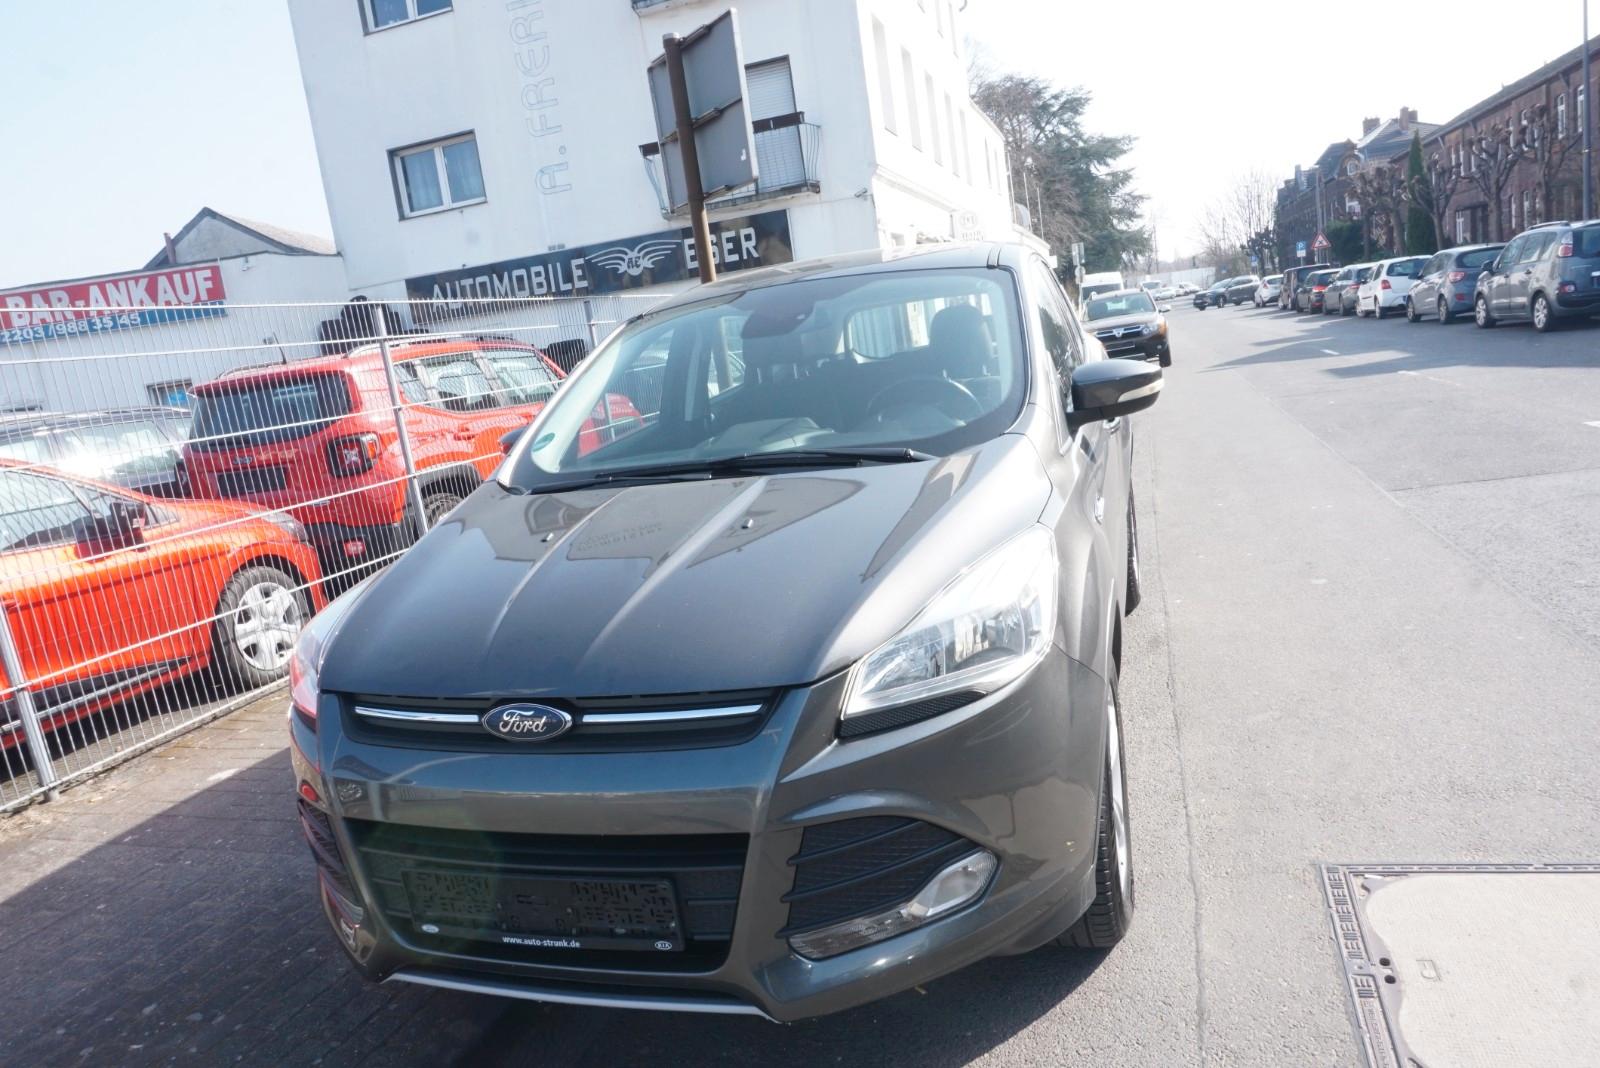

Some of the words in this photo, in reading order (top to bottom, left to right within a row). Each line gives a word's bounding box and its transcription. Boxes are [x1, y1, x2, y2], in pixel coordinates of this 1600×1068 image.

[431, 257, 588, 313] AUTOMOBILE
[5, 269, 214, 328] BAR-ANKAUF
[91, 316, 114, 330] 35
[119, 312, 141, 325] 45
[498, 709, 547, 733] Ford
[502, 936, 581, 949] www.auto-strunk.de
